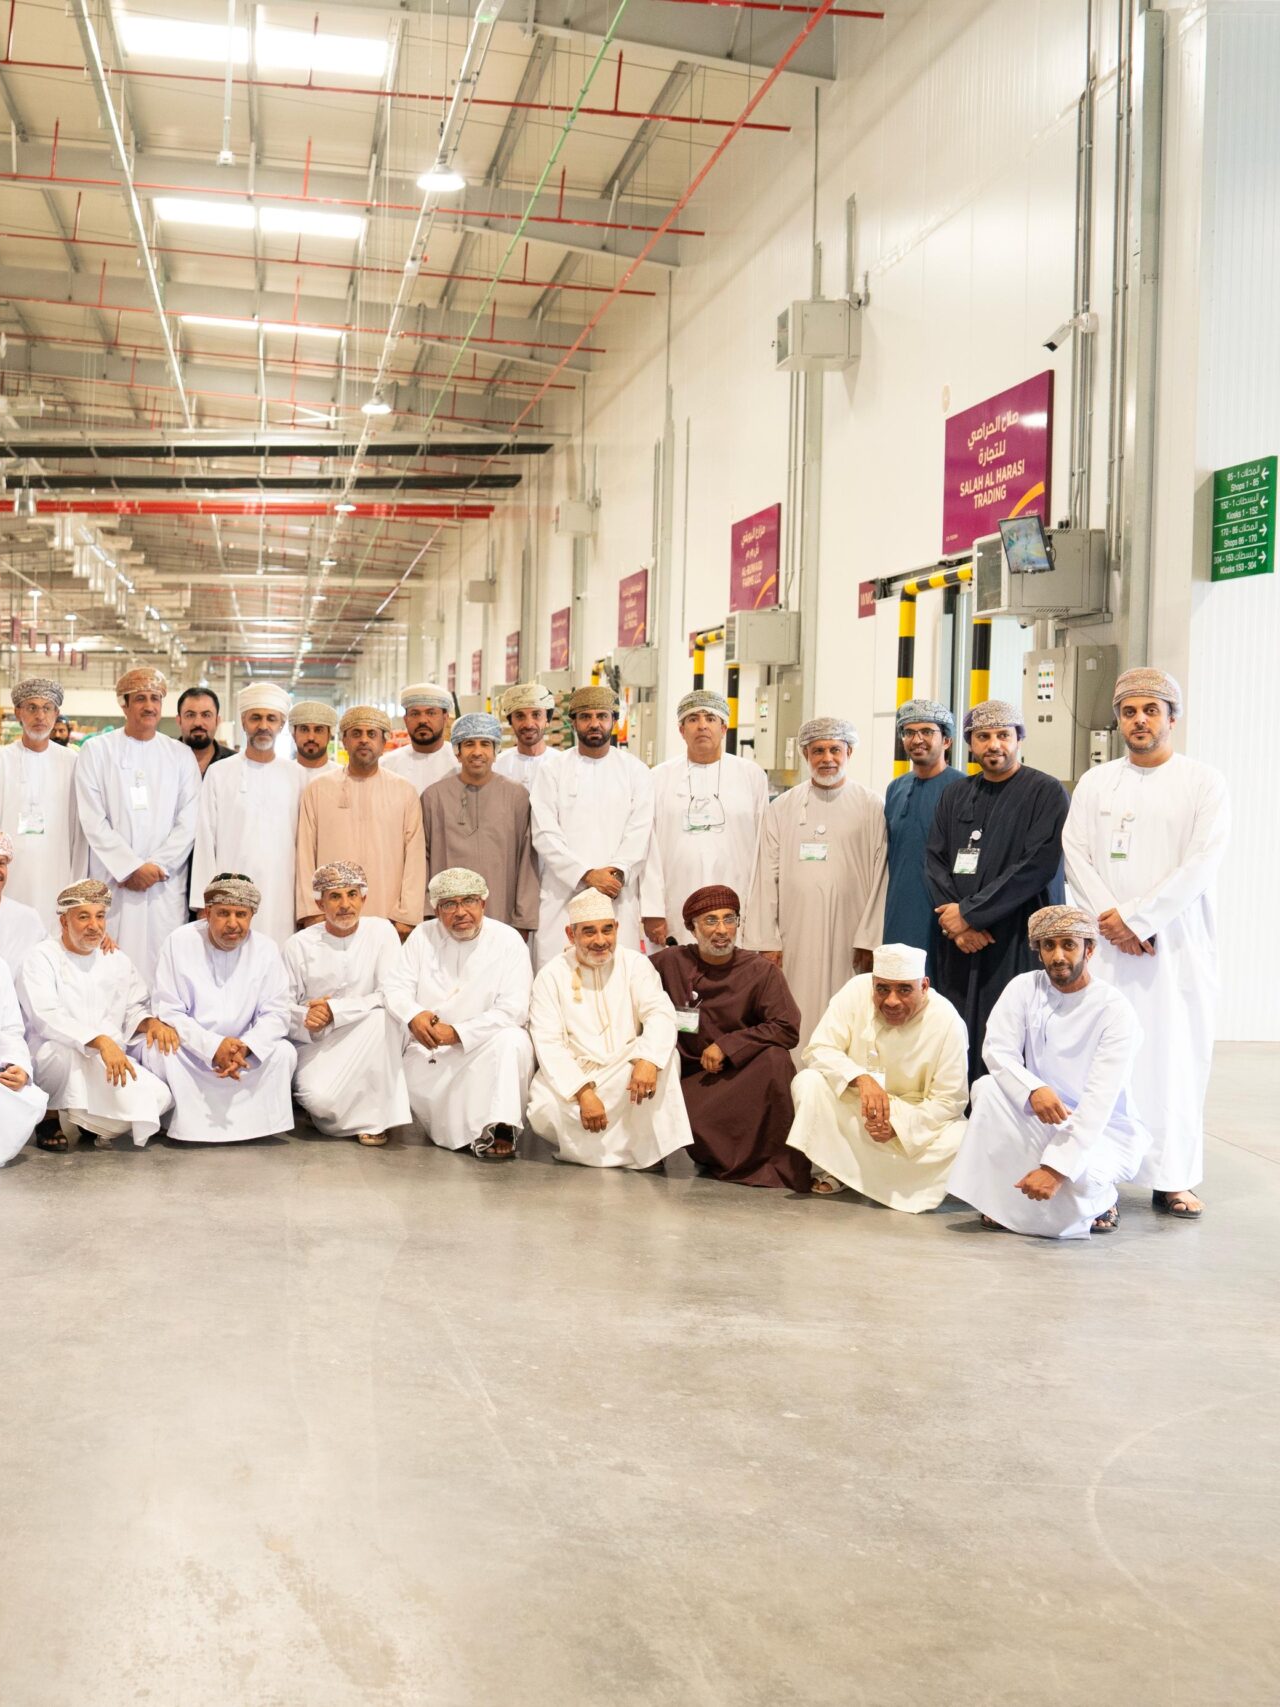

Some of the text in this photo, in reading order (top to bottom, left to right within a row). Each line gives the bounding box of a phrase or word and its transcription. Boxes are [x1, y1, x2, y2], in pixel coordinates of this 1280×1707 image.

[967, 409, 1019, 451] صلاح الحراصي
[978, 439, 1006, 467] للتجارة
[960, 459, 1025, 497] SALAH AL HARASI
[1230, 482, 1245, 492] Shops
[973, 484, 1007, 509] TRADING
[1226, 510, 1241, 519] Kiosks
[1223, 539, 1238, 548] Shops
[1220, 565, 1235, 574] Kiosks
